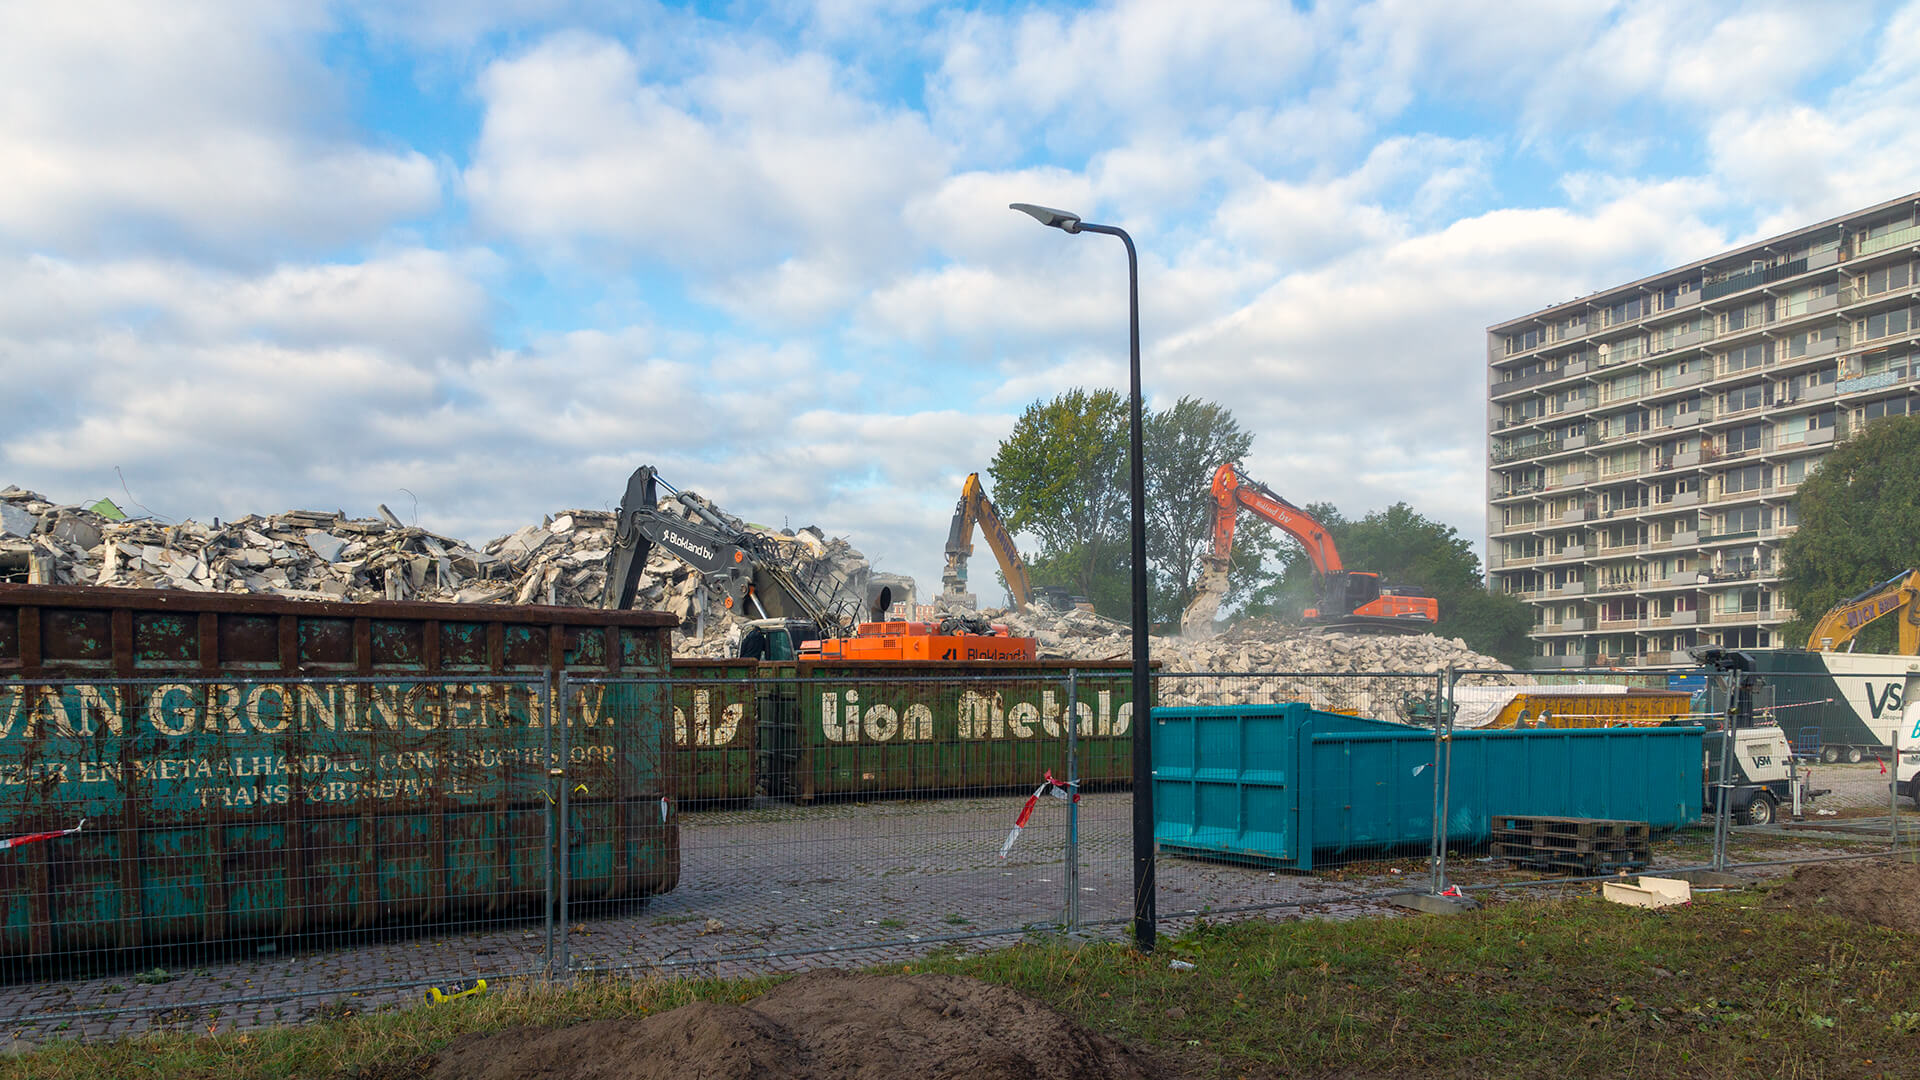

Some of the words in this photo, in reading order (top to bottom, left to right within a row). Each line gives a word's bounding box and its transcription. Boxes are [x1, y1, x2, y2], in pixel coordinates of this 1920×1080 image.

[669, 531, 704, 556] Blokland
[702, 546, 714, 561] bv
[148, 683, 511, 737] GRONINGEN
[822, 689, 933, 742] Lion
[957, 689, 1134, 739] Metals
[1865, 682, 1903, 719] VS
[80, 761, 122, 783] EN
